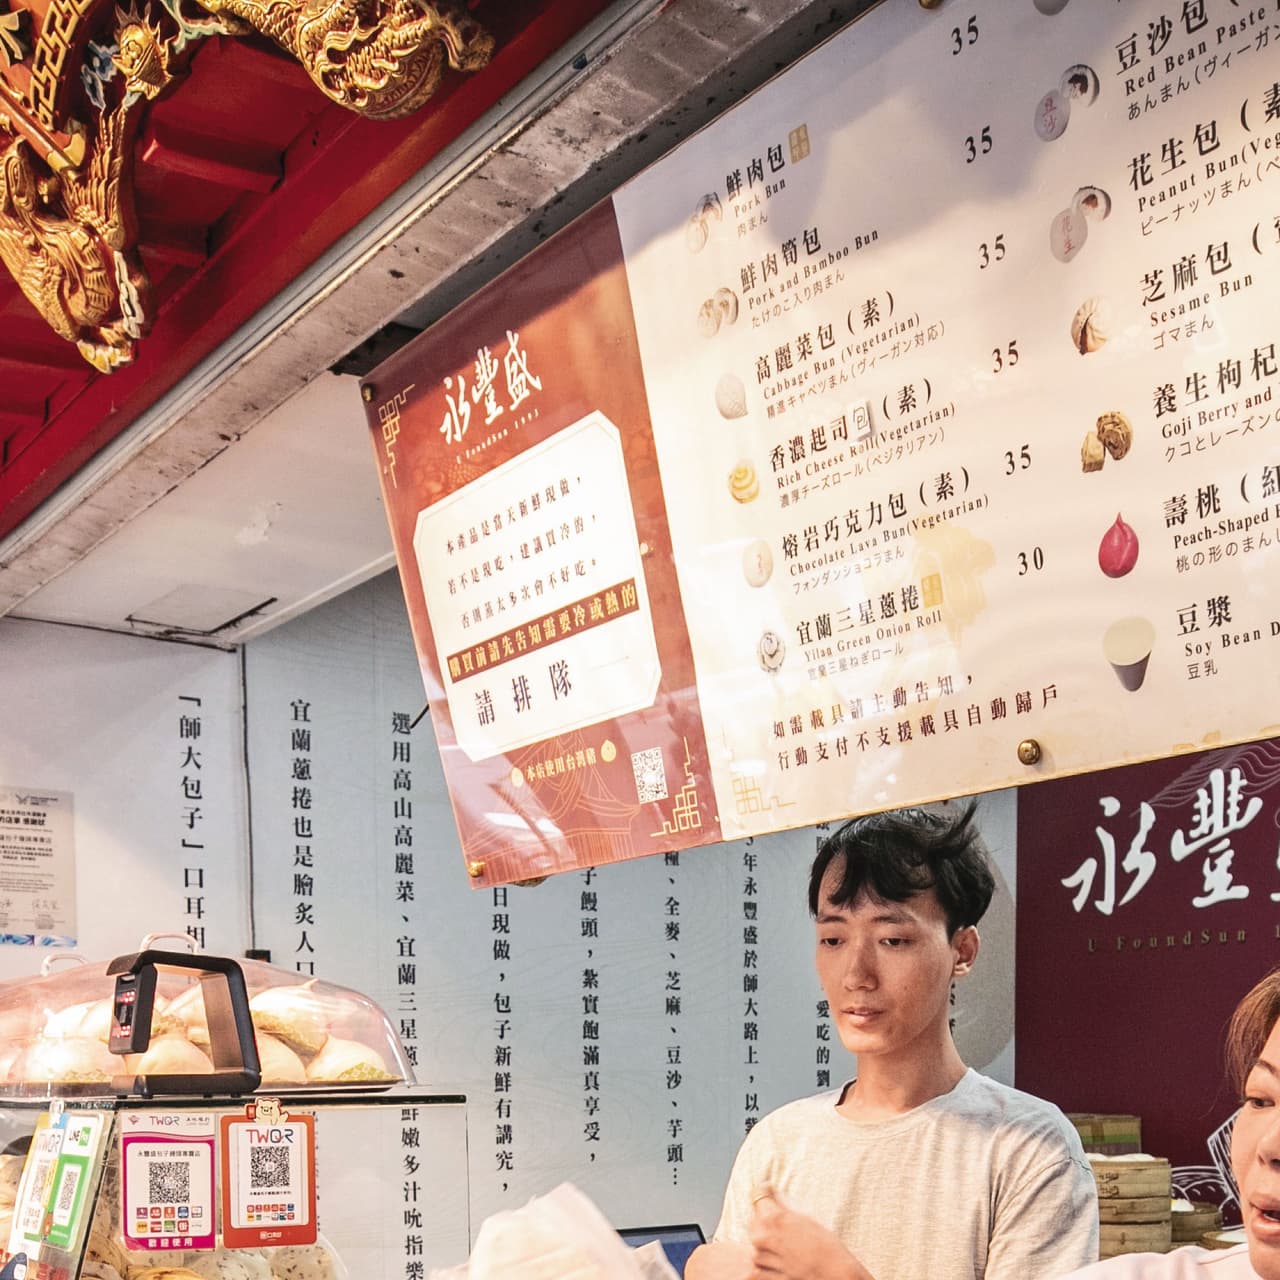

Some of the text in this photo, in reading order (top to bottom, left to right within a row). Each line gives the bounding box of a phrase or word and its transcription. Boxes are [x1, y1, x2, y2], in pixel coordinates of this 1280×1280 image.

[951, 13, 981, 57] 35
[1124, 69, 1156, 97] Red
[1164, 37, 1208, 75] Bean
[1217, 6, 1267, 45] Paste
[964, 124, 994, 165] 35
[724, 143, 786, 203] 鮮肉包
[1137, 173, 1197, 214] Peanut
[732, 178, 788, 220] Pork Bun
[736, 211, 769, 240] 肉まん
[739, 225, 824, 295] 鮮肉筍包
[747, 228, 880, 311] Pork and Bamboo Bun
[978, 233, 1007, 270] 35
[1149, 270, 1255, 328] Sesame Bun
[1151, 315, 1215, 353] ゴマまん
[762, 311, 921, 401] Cabbage Bun (Vegetarian)
[991, 339, 1020, 374] 35
[439, 329, 542, 445] 永豐盛
[1160, 413, 1193, 443] Goji
[1197, 398, 1241, 432] Berry
[1244, 384, 1274, 410] and
[776, 470, 802, 490] Rich
[805, 453, 845, 477] Cheese
[1003, 443, 1033, 477] 35
[1172, 507, 1271, 550] Peach-Shaped
[788, 546, 847, 578] Chocolate
[849, 536, 879, 560] Lava
[1017, 545, 1046, 577] 30
[803, 608, 944, 664] Yilan Green Onion Roll
[1175, 594, 1233, 638] 豆漿
[1184, 637, 1214, 661] Soy
[1221, 626, 1262, 651] Bean
[1187, 659, 1219, 683] 豆乳
[474, 658, 574, 728] 請排隊
